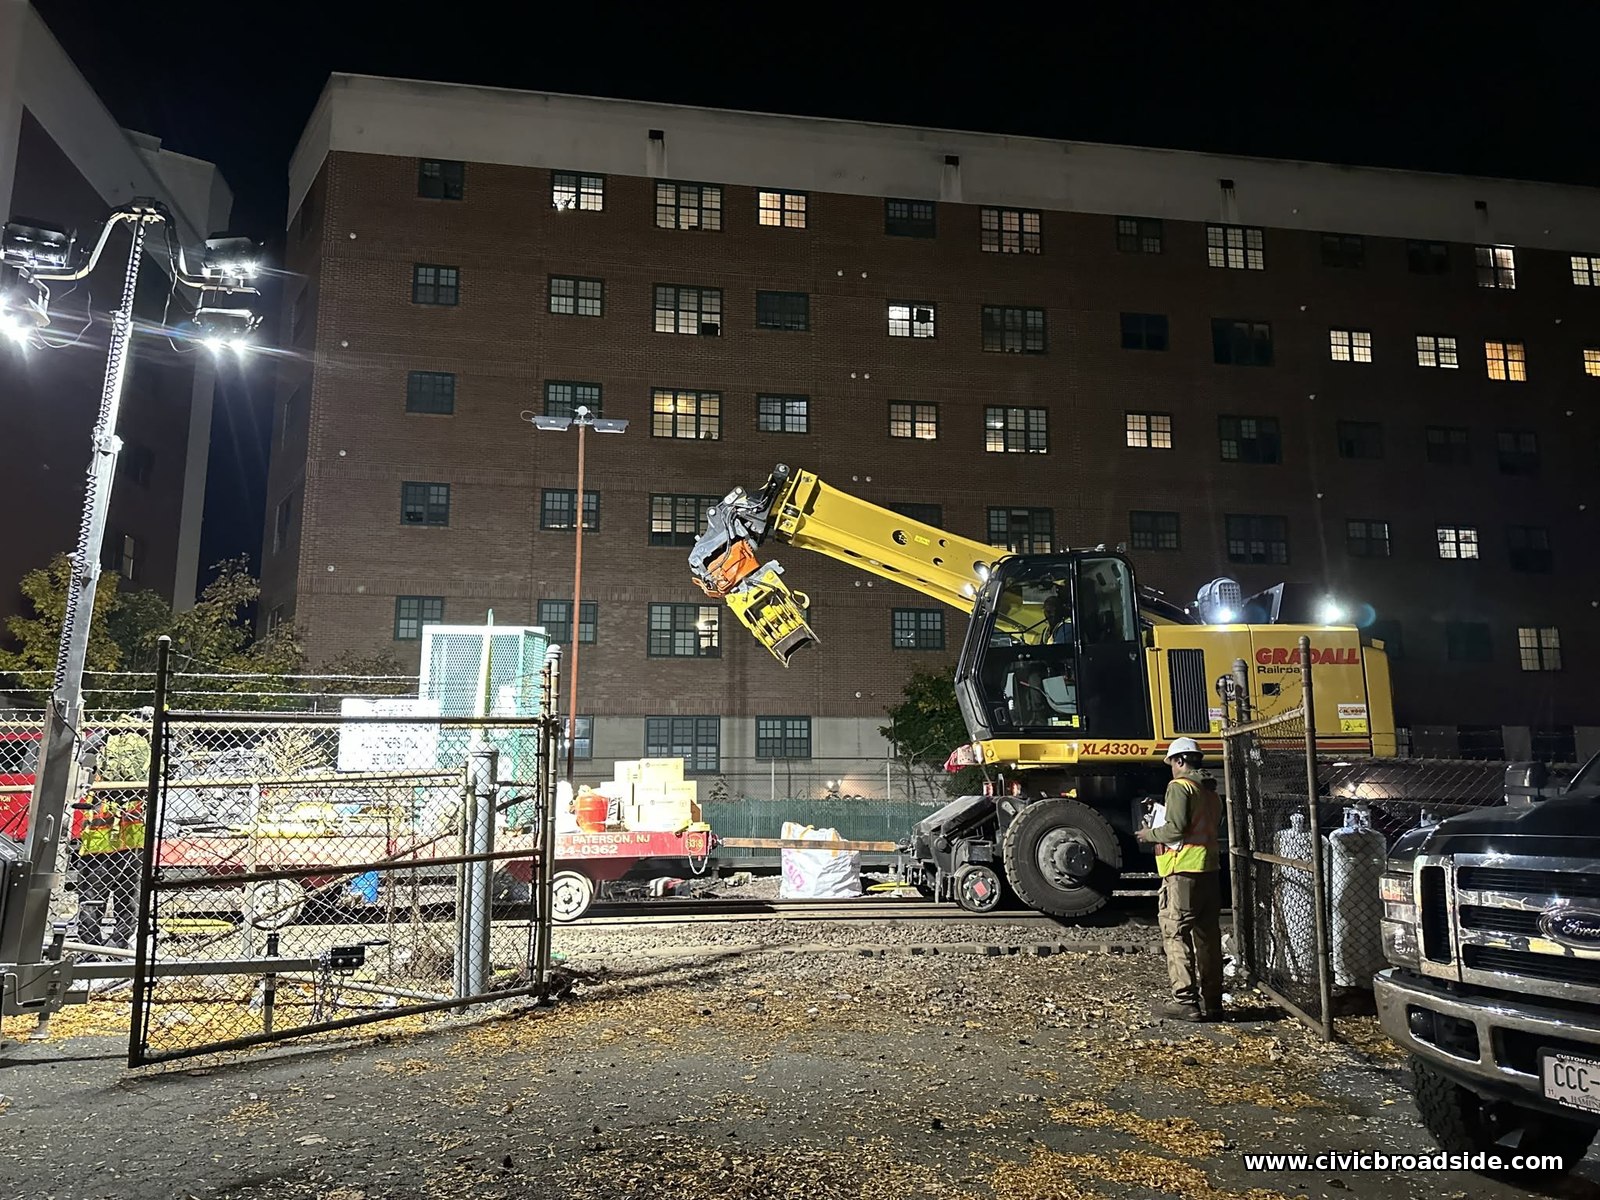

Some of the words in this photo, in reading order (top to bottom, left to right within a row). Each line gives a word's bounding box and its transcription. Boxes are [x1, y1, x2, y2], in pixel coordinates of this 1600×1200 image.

[1256, 648, 1360, 665] GRADALL
[1258, 666, 1301, 674] Railroa
[573, 835, 633, 845] PATERSON,
[636, 834, 650, 843] NJ
[1556, 1054, 1586, 1063] CUSTOM
